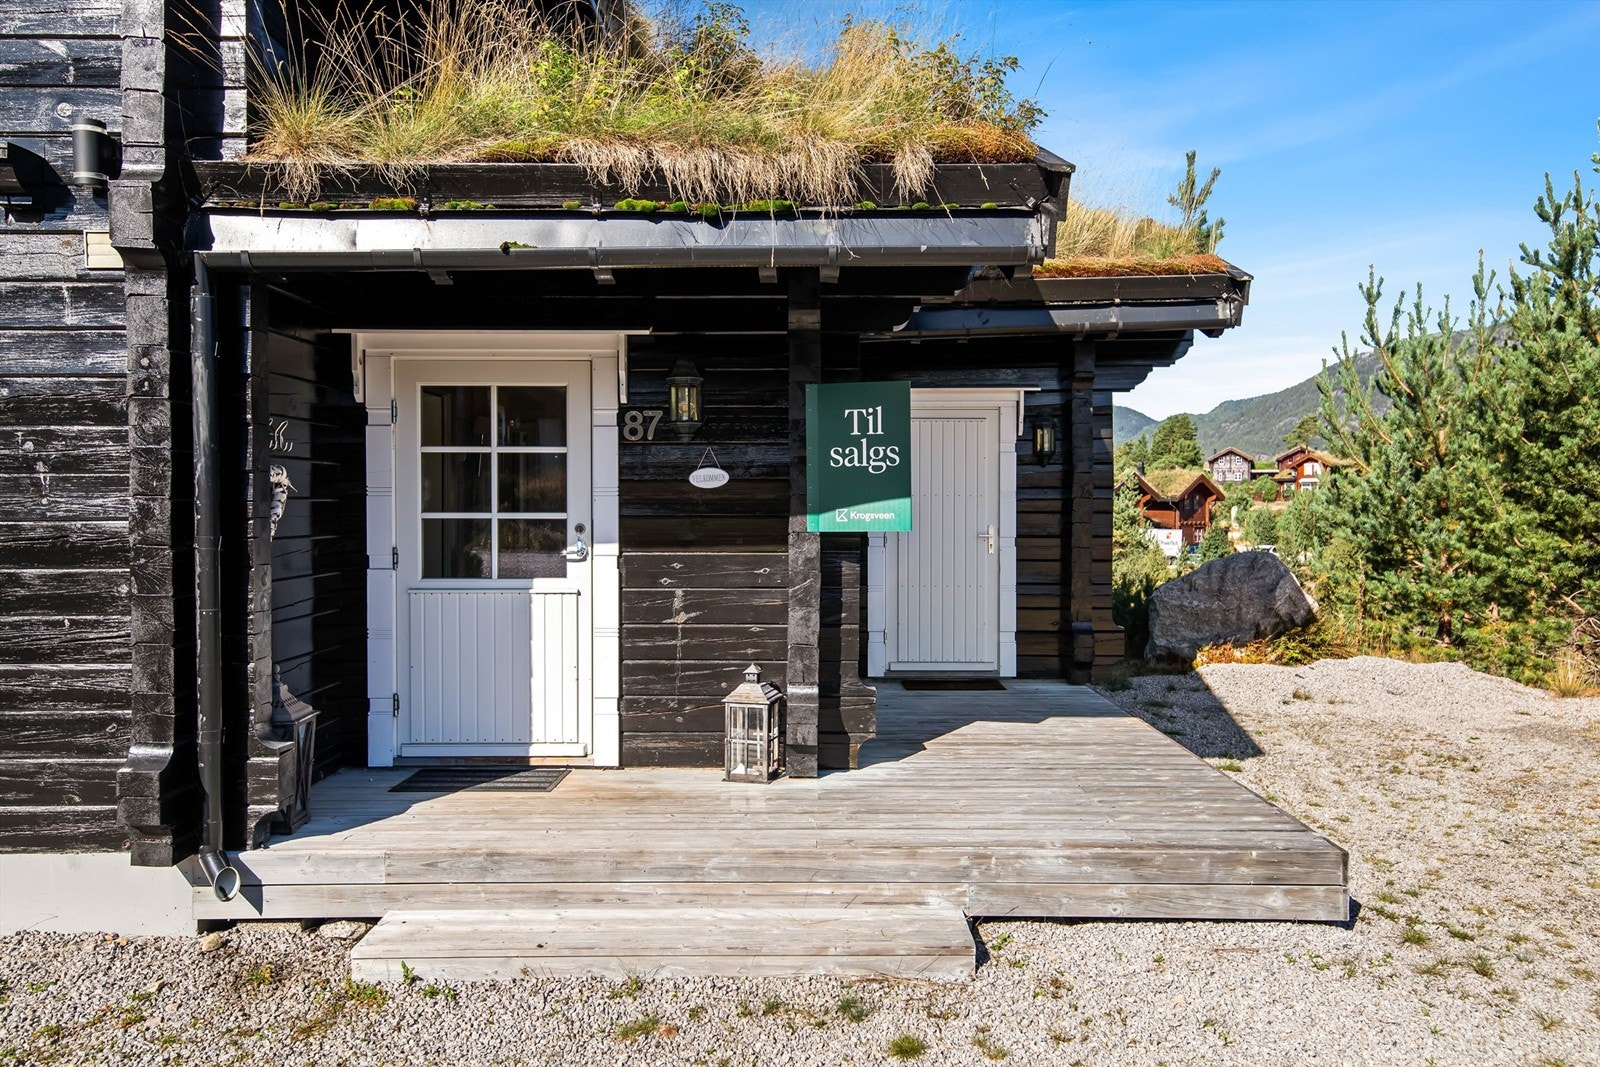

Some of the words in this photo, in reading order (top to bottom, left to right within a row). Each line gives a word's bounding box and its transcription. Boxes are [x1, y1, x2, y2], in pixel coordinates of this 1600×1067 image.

[623, 410, 663, 441] 87
[844, 405, 884, 435] Til
[830, 437, 900, 474] salgs
[691, 473, 726, 483] VELKOMMEN
[849, 510, 895, 522] Krogsveen
